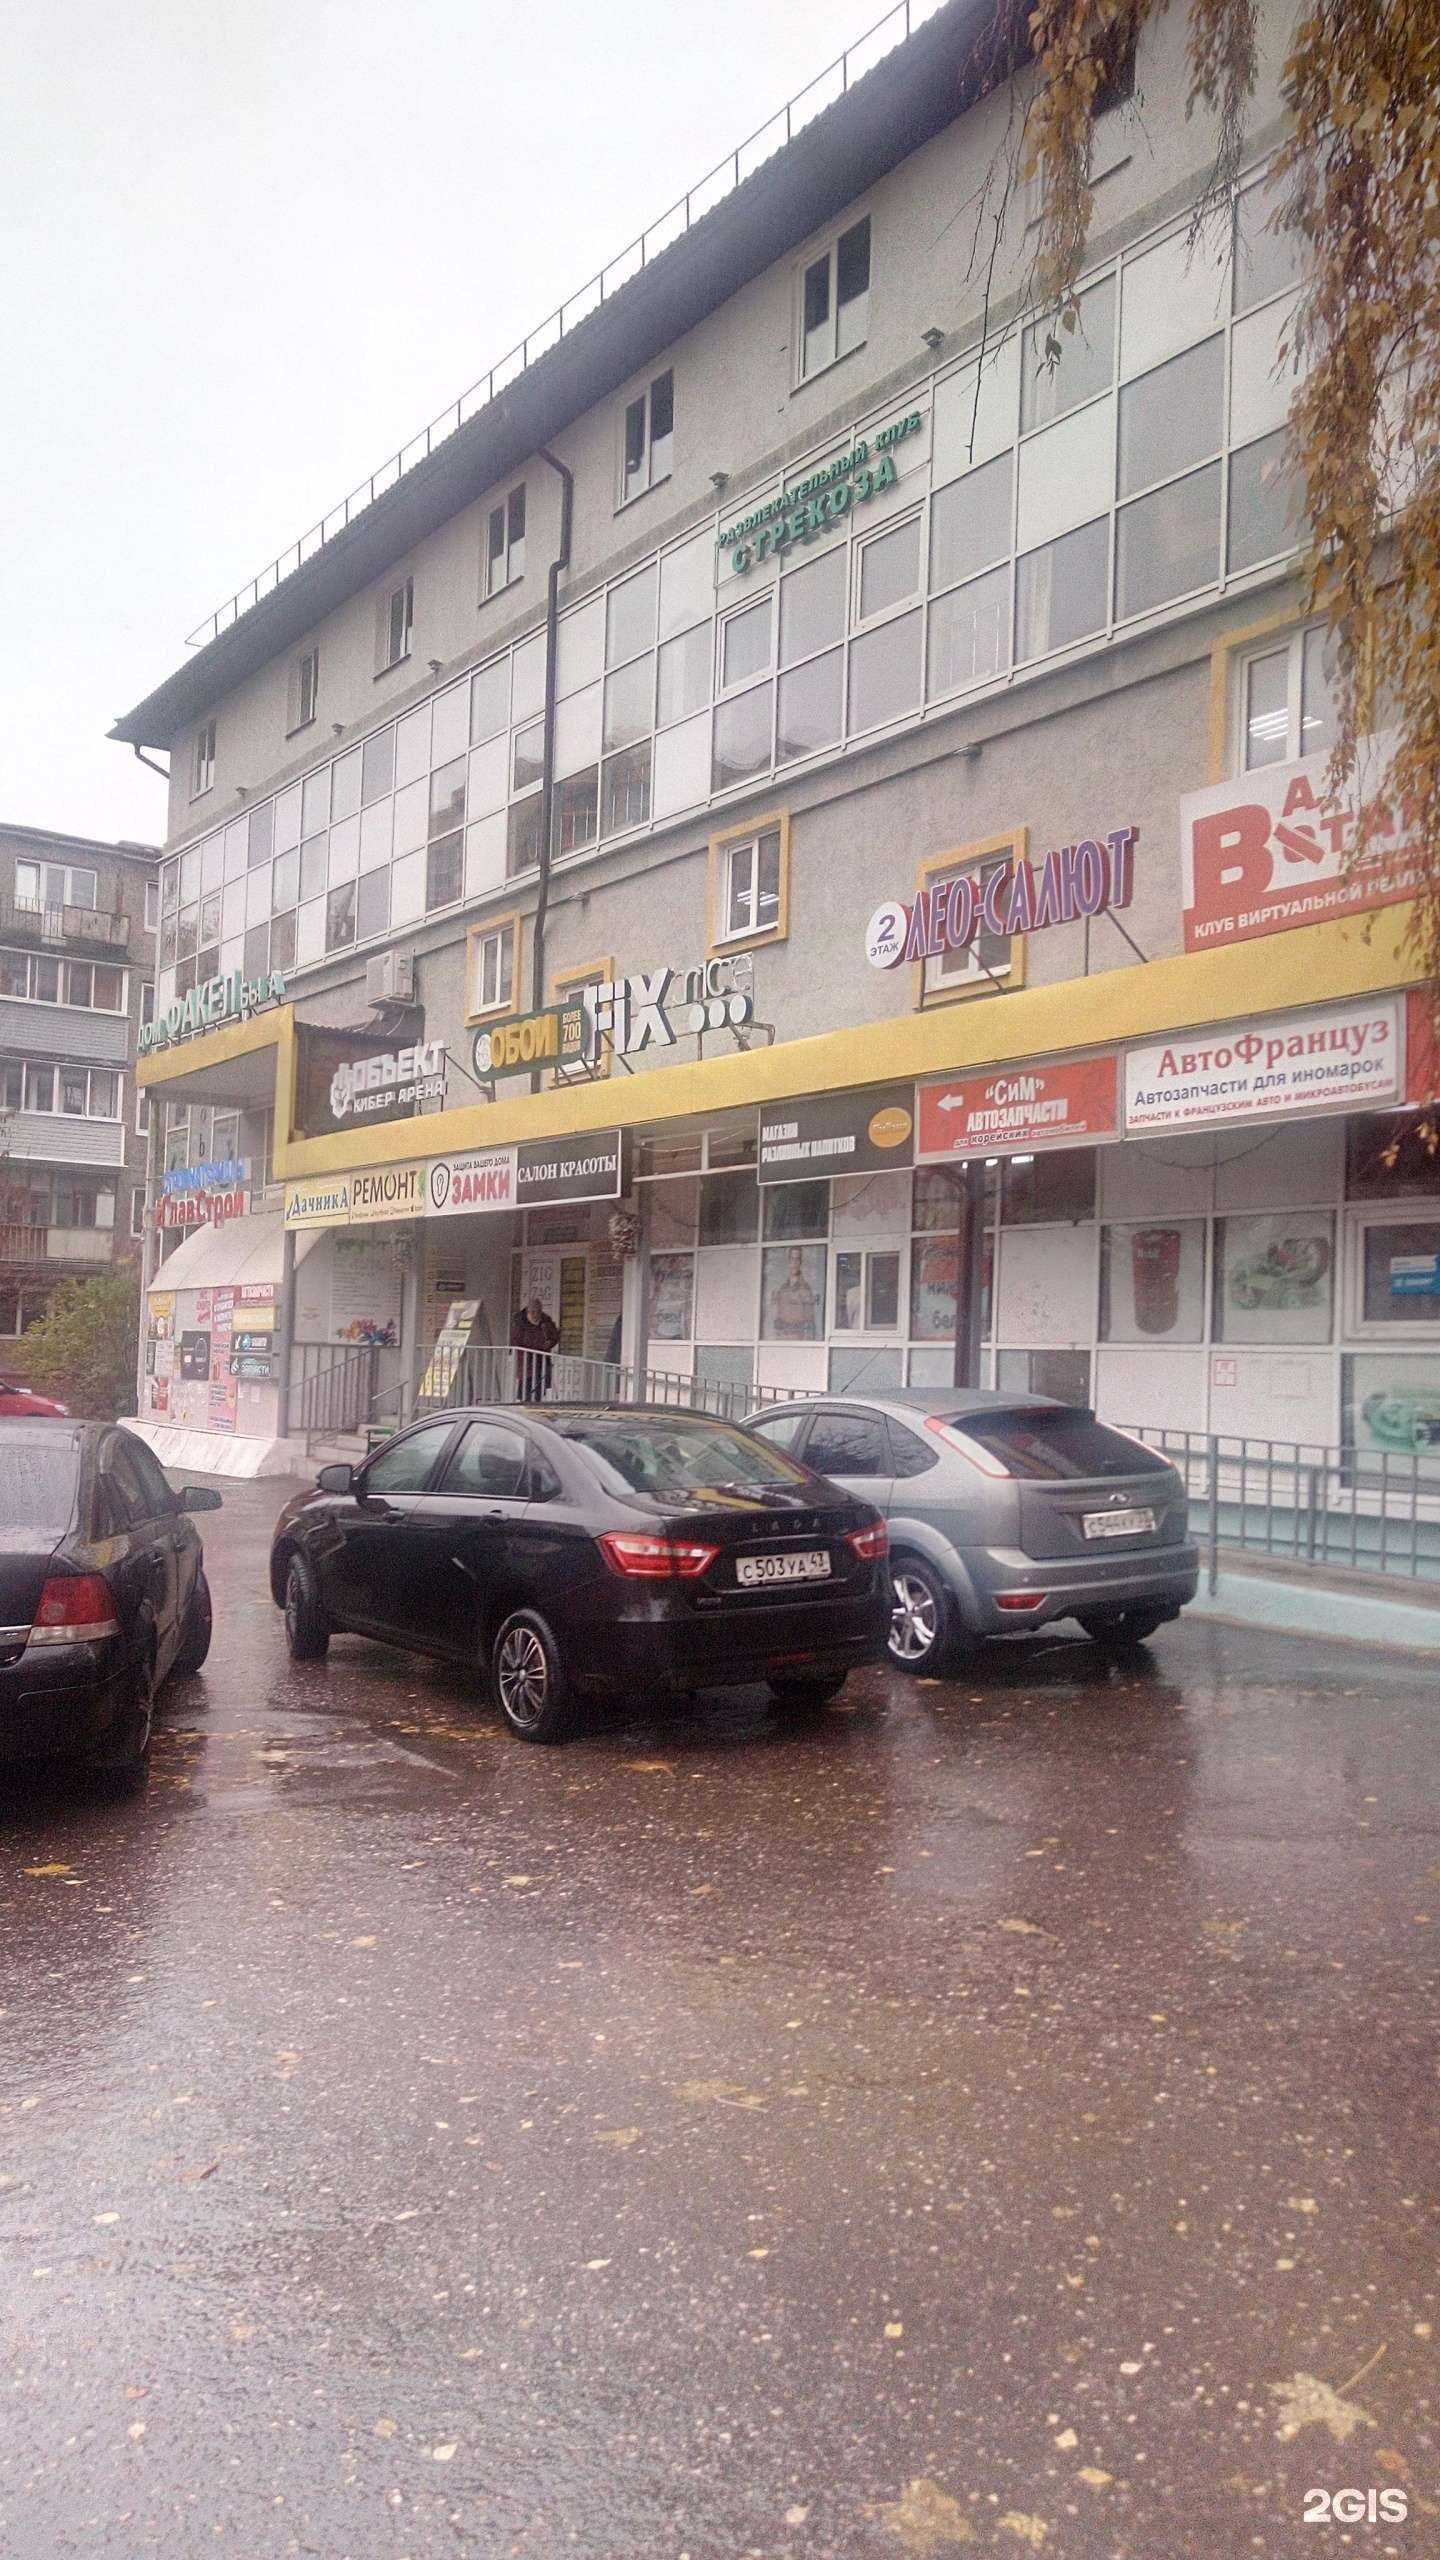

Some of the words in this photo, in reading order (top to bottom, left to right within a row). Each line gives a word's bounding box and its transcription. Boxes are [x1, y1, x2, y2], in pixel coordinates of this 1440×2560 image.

[718, 440, 868, 548] РАЗВЛЕКАТЕЛЬНЫЙ
[875, 410, 921, 452] КЛУБ
[731, 455, 897, 574] СТРЕКОЗА
[905, 826, 1139, 961] ЛЕО-САЛЮТ
[1194, 916, 1233, 938] КЛУБ
[1238, 882, 1362, 927] ВИРТУАЛЬНОЙ
[876, 914, 895, 943] 2
[869, 941, 900, 958] ЭТАЖ
[165, 969, 242, 1034] ФАКЕЛ
[583, 967, 676, 1060] FIX
[491, 1014, 558, 1068] ОБОИ
[562, 1021, 582, 1042] 700
[1157, 1020, 1389, 1078] АвтоФранцуз
[397, 1081, 447, 1103] АРЕНА
[1134, 1074, 1247, 1106] Автозапчасти
[1252, 1071, 1286, 1091] для
[1292, 1057, 1384, 1085] иномарок
[353, 1089, 395, 1113] КИБЕР
[967, 1098, 1068, 1132] АВТОЗАПЧАСТИ
[1128, 1110, 1171, 1125] ЗАПЧАСТИ
[1174, 1108, 1181, 1118] К
[1183, 1096, 1253, 1117] ФРАНЦУЗСКИМ
[1256, 1093, 1281, 1107] АВТО
[1284, 1092, 1292, 1102] И
[1294, 1076, 1393, 1101] МИКРОАВТОБУСАМ
[762, 1122, 798, 1142] МАГАЗИН
[971, 1128, 1030, 1146] корейских
[517, 1162, 557, 1182] САЛОН
[560, 1154, 617, 1176] КРАСОТЫ
[353, 1170, 417, 1205] РЕМОНТ
[452, 1170, 510, 1205] ЗАМКИ
[808, 1552, 825, 1570] 43
